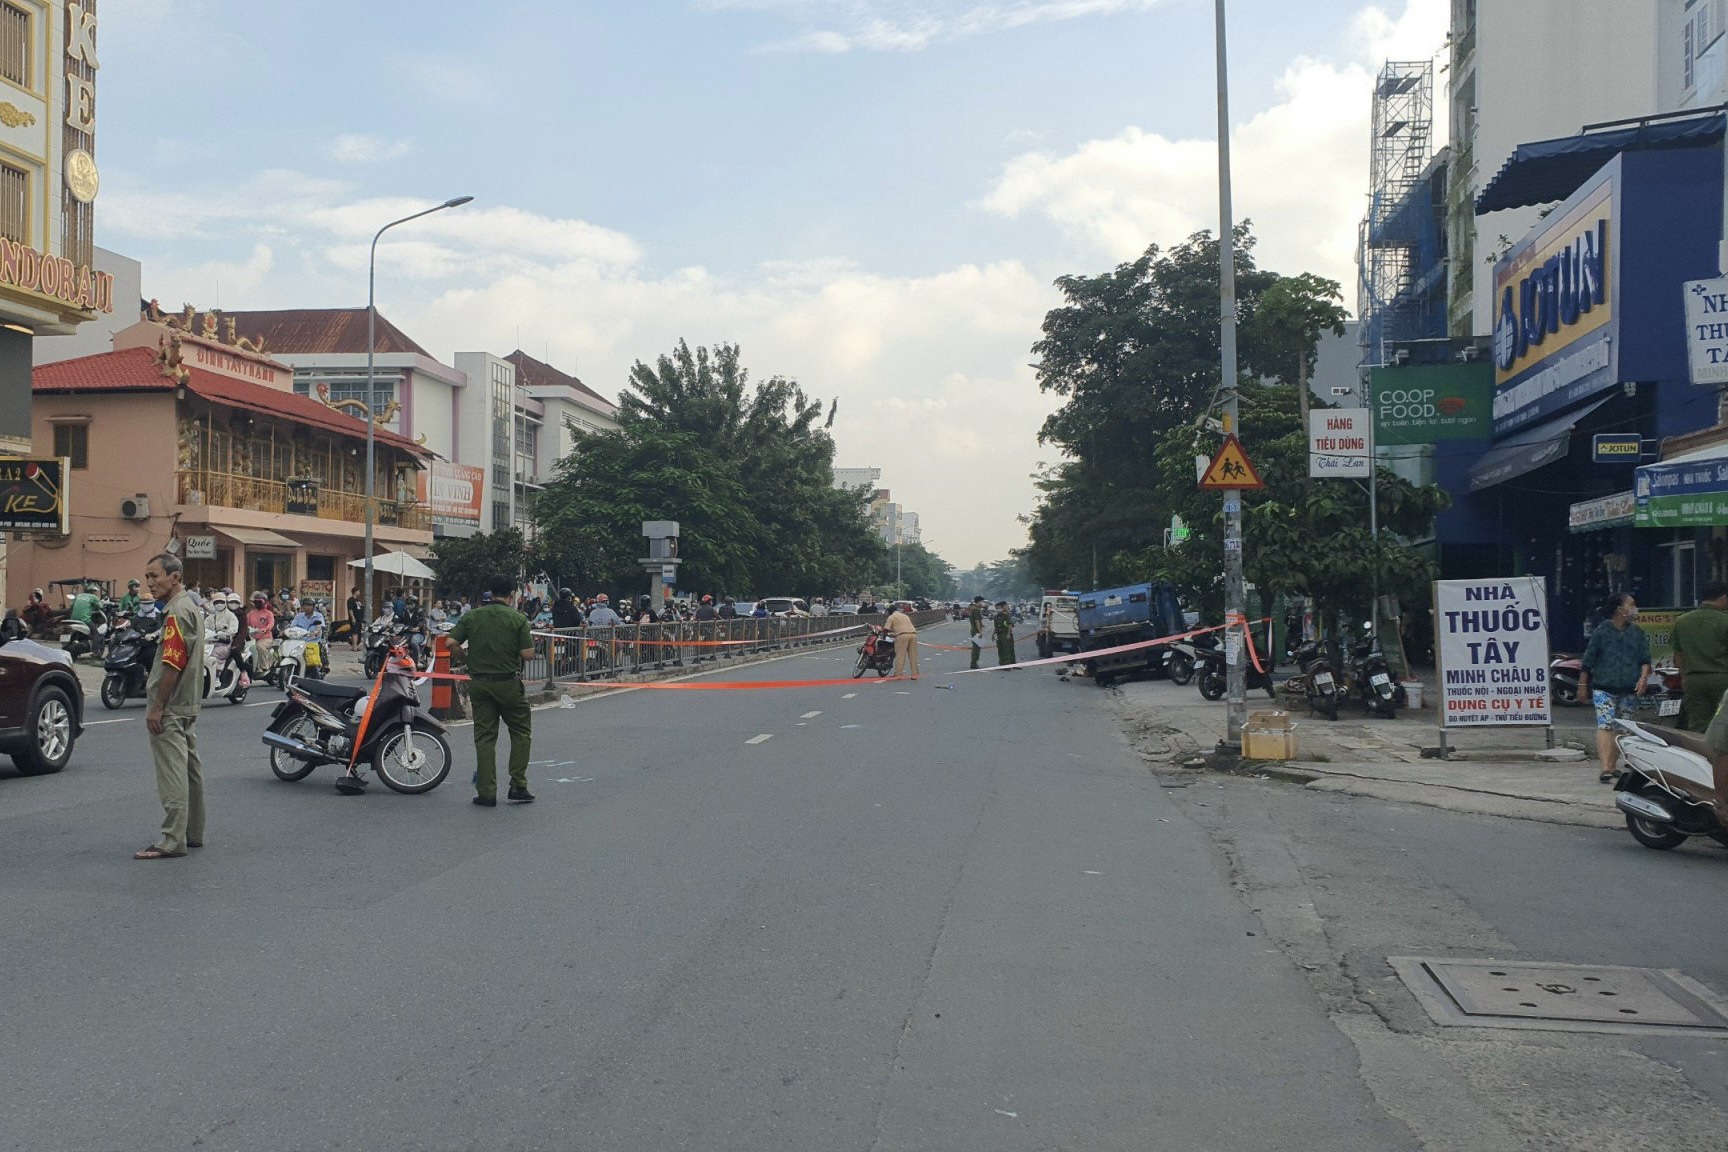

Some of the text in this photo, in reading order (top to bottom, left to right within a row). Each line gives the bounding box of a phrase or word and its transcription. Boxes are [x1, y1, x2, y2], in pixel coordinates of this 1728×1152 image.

[1517, 219, 1605, 358] JOTUN
[1380, 404, 1435, 419] FOOD
[1326, 416, 1353, 430] HÀNG
[1315, 436, 1364, 450] TIÊU DÙNG
[1608, 443, 1637, 453] JOTUN
[1465, 583, 1516, 601] NHÀ
[1445, 601, 1540, 633] THUỐC
[1467, 637, 1520, 664] TÂY
[1446, 666, 1545, 684] MINH CHÂU 8
[1448, 685, 1473, 696] THUỐC
[1496, 686, 1522, 697] NGOẠI
[1448, 695, 1545, 712] DỤNG CỤ Y TẾ
